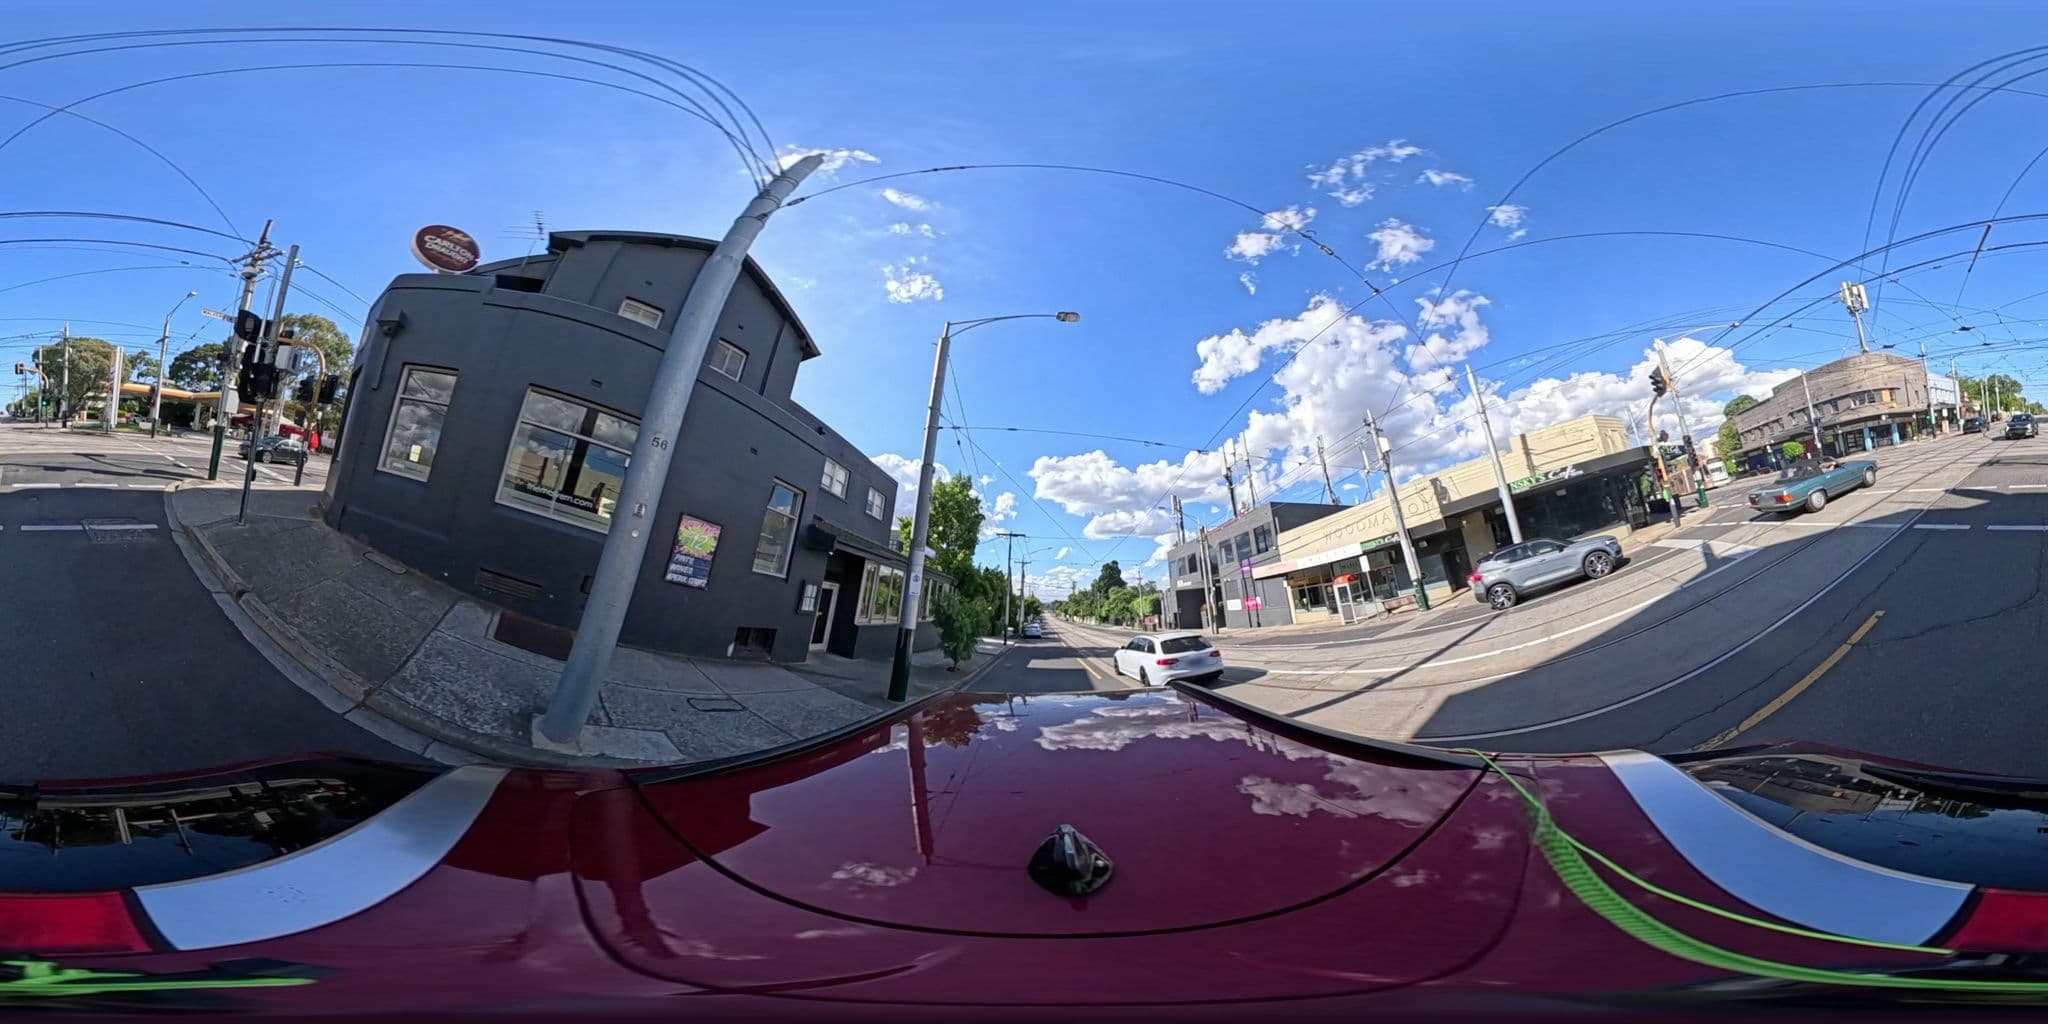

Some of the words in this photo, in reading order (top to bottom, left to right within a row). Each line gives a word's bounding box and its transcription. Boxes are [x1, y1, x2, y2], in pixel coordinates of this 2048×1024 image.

[424, 235, 475, 261] CARLTON
[424, 242, 469, 264] DRAUGHT
[651, 436, 669, 450] 56
[1324, 492, 1434, 542] WOODMAON
